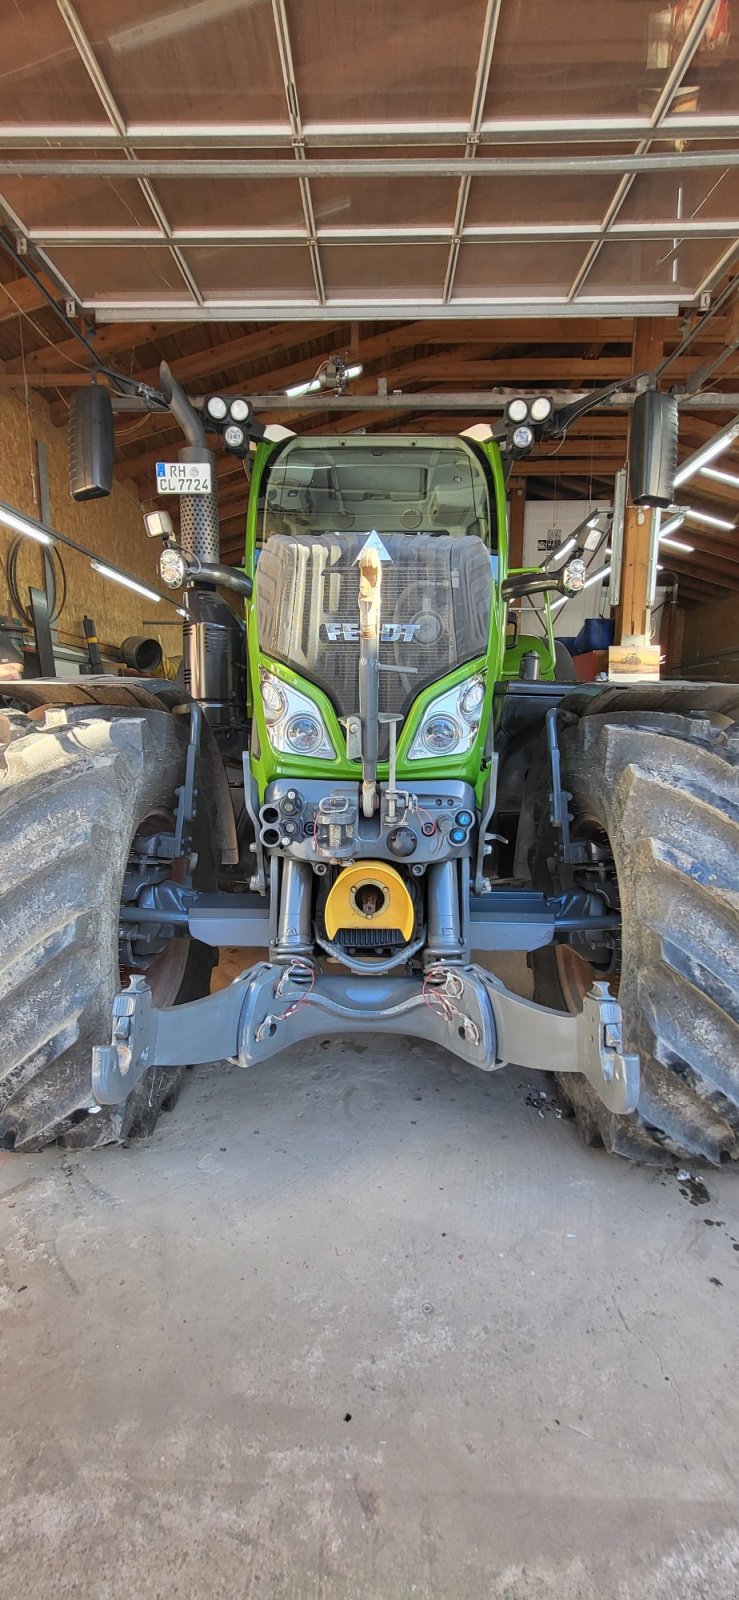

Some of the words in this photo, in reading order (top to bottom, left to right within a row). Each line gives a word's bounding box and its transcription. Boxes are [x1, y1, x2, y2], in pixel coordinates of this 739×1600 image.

[170, 465, 186, 477] RH
[160, 479, 176, 491] CL
[178, 479, 208, 491] 7724
[325, 623, 420, 642] FEDT
